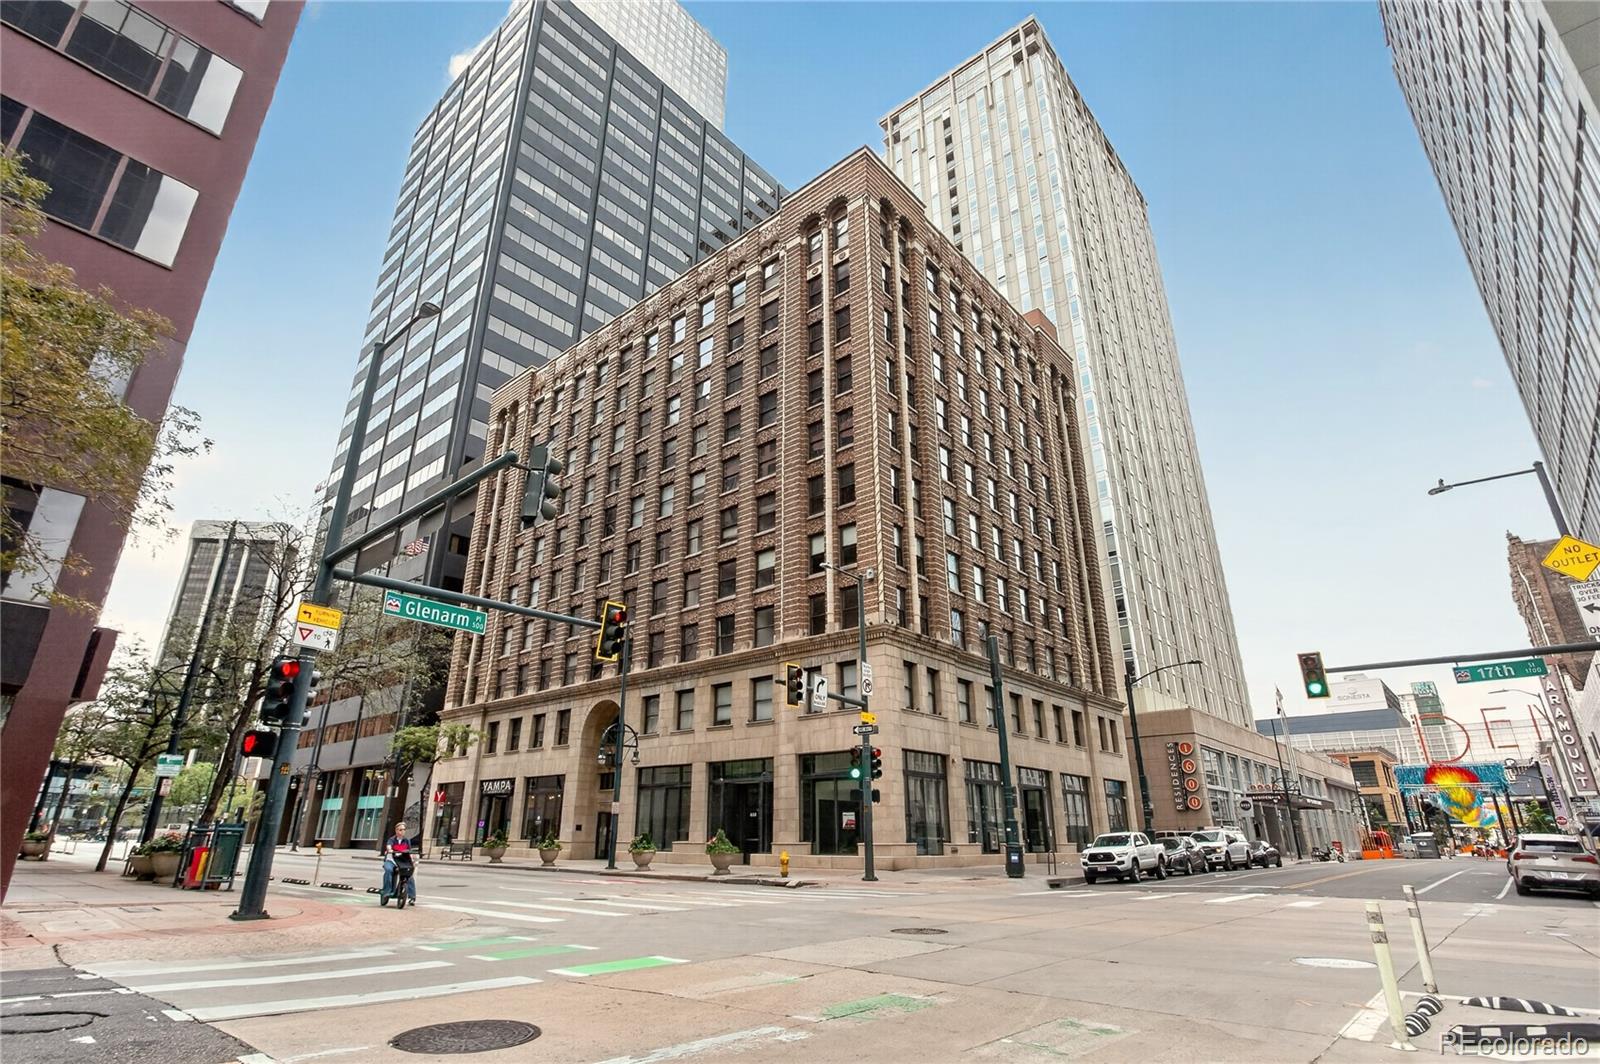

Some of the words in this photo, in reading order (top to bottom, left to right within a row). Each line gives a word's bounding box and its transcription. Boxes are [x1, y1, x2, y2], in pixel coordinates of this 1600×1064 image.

[1563, 544, 1581, 554] NO
[1552, 552, 1599, 568] OUTLET
[1578, 587, 1598, 595] OVER
[405, 601, 470, 627] Glenarm
[472, 622, 484, 630] 500
[1476, 664, 1515, 679] 17th
[1545, 679, 1590, 788] ARAMOUNT
[1166, 742, 1184, 810] RESIDENCES
[482, 780, 512, 792] YAMPA
[436, 791, 445, 802] Y
